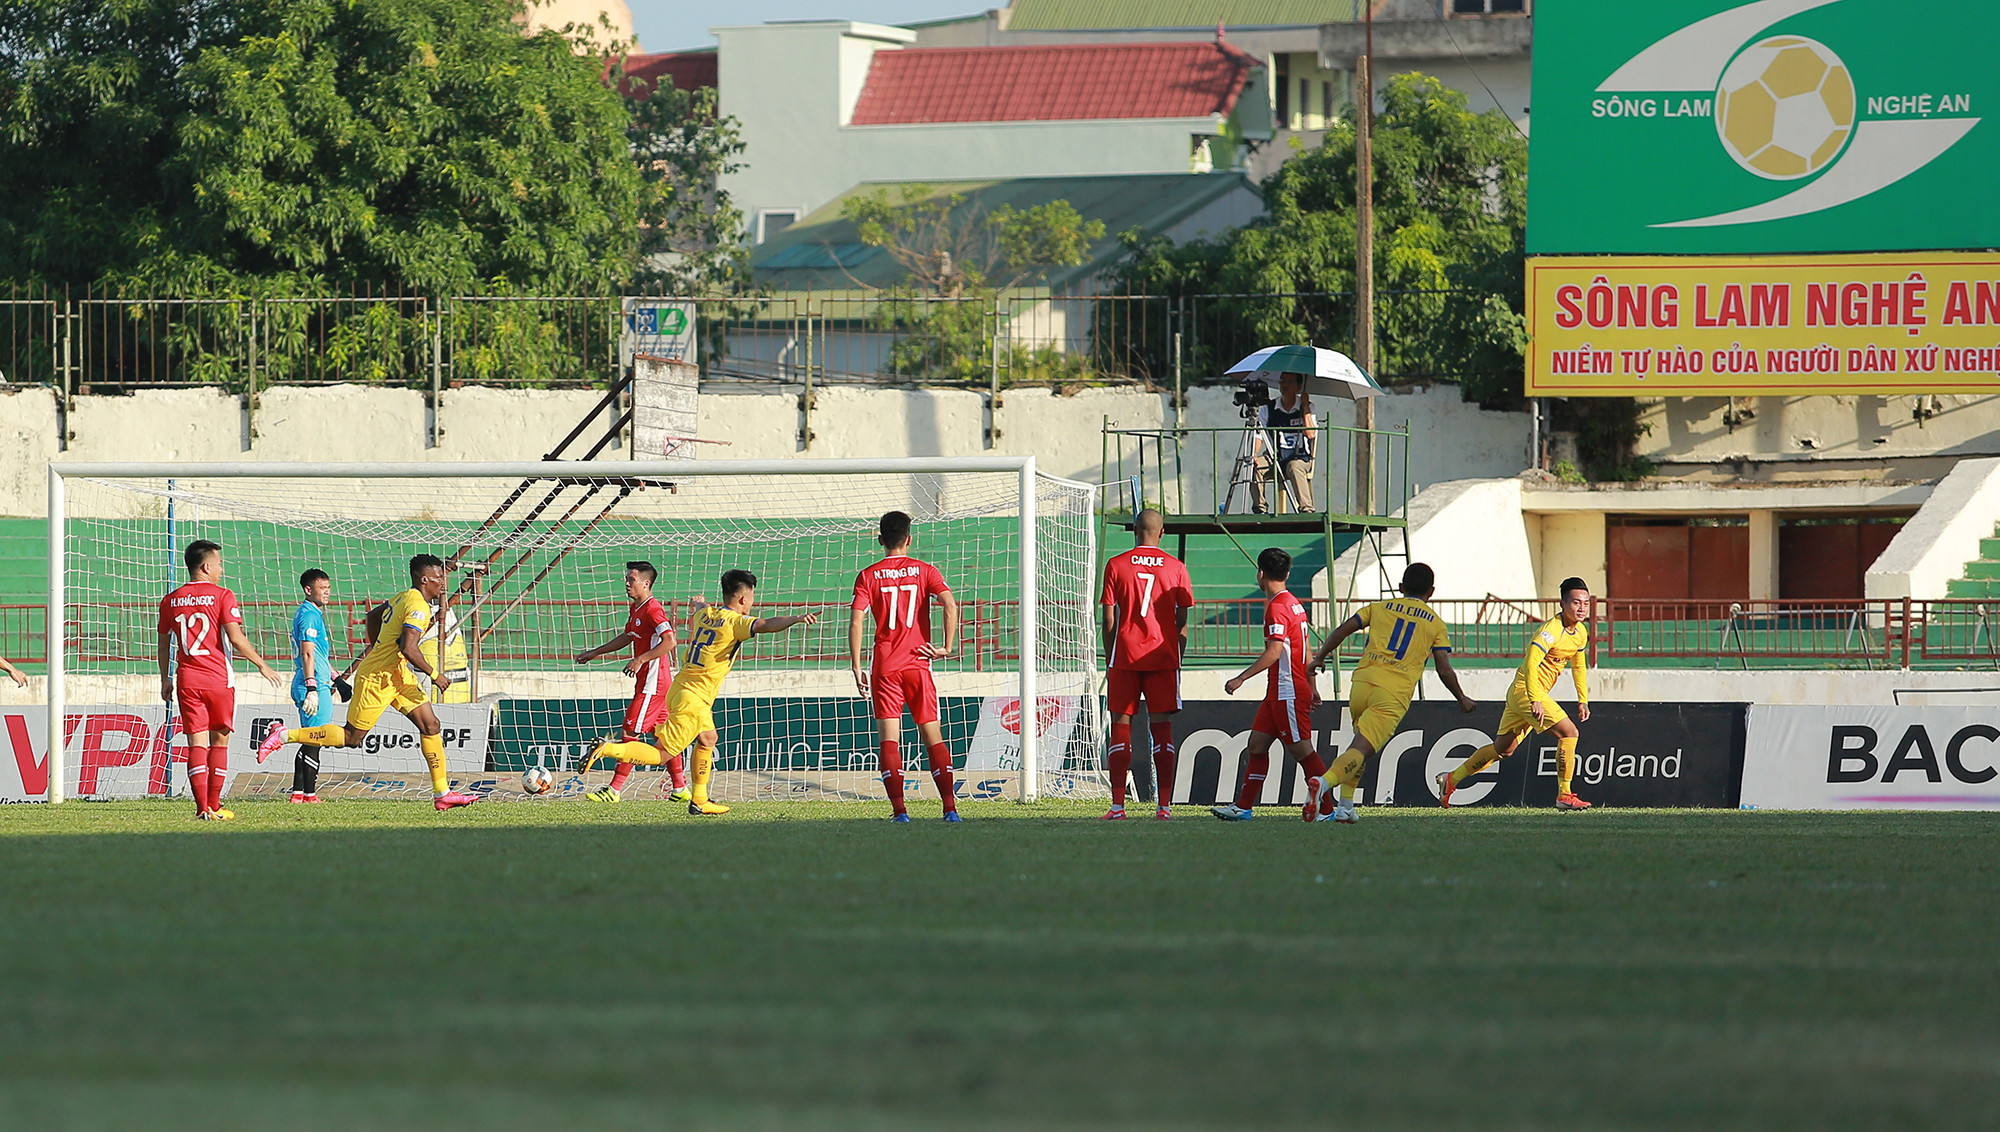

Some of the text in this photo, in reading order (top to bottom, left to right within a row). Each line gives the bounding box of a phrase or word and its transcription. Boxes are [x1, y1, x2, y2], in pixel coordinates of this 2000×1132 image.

[1591, 95, 1711, 118] SÔNG LAM
[1867, 94, 1970, 117] NGHỆ AN
[1554, 275, 1679, 329] SÔNG
[1694, 283, 1790, 328] LAM
[1805, 272, 1928, 336] NGHỆ
[1552, 343, 1613, 374] NIỀM
[1620, 347, 1652, 379] TỰ
[1656, 345, 1703, 374] HÀO
[1711, 343, 1759, 373] CỦA
[1766, 344, 1839, 373] NGƯỜI
[1847, 344, 1896, 372] DÂN
[1904, 343, 1939, 372] XỨ
[1131, 555, 1164, 567] CAIQUE
[880, 584, 918, 631] 77
[1137, 572, 1155, 618] 7
[174, 612, 211, 656] 12
[688, 626, 717, 667] 12
[1172, 705, 1500, 807] mitre
[1827, 724, 2000, 784] BAC
